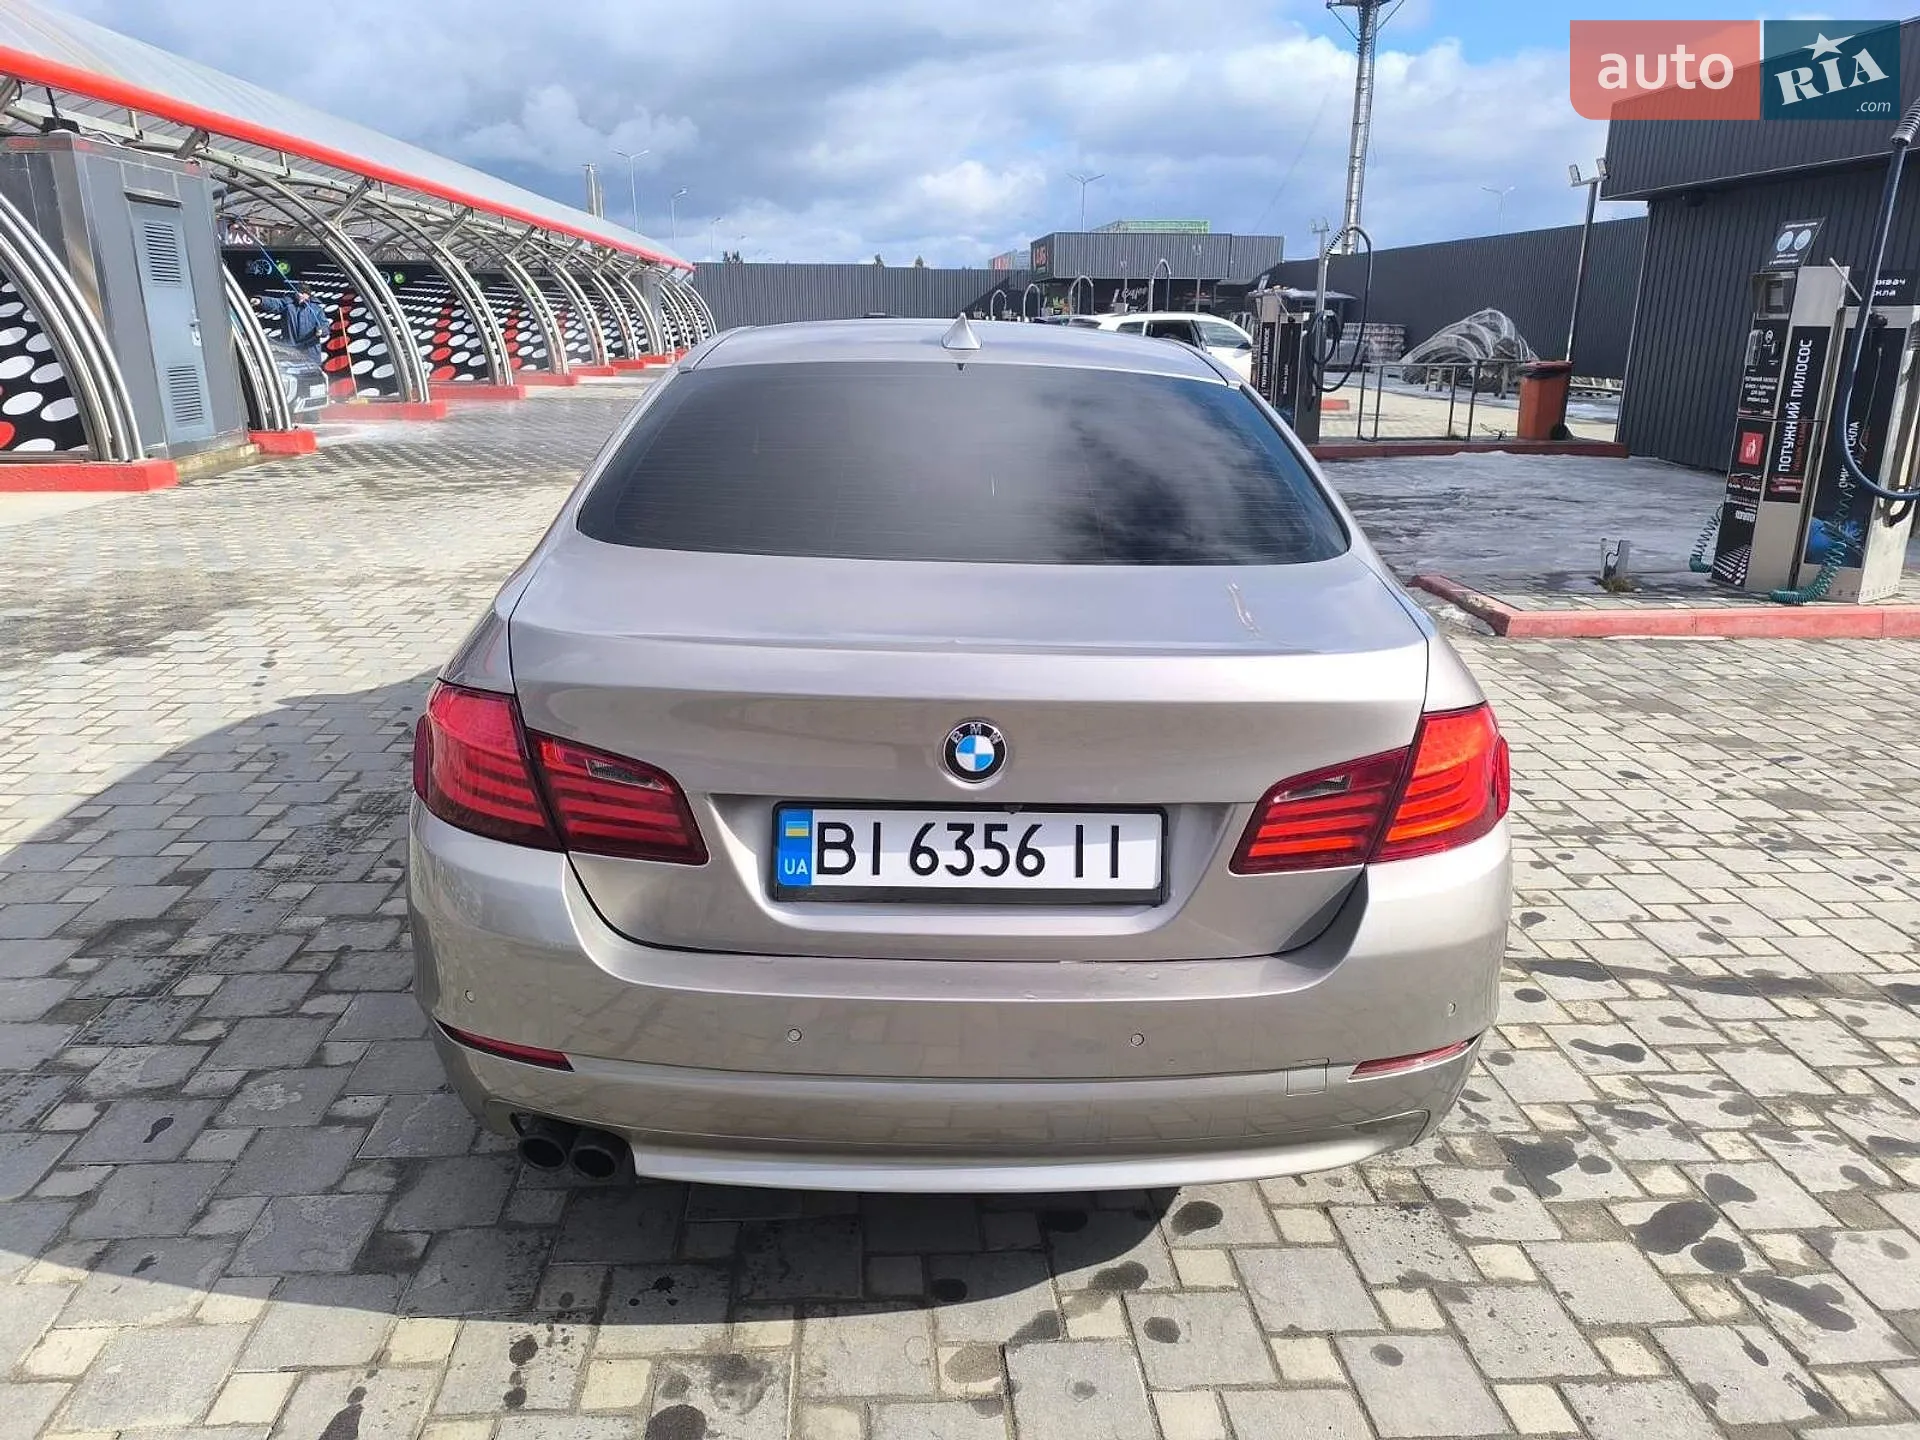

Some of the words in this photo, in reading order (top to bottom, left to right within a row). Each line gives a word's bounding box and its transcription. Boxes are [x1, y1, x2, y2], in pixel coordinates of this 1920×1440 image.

[1778, 401, 1802, 472] ПОТУЖНИЙ
[1790, 339, 1813, 398] ПИЛОСОС
[950, 723, 1003, 744] BMW
[784, 858, 809, 876] UA
[816, 821, 881, 877] BI
[908, 821, 1047, 879] 6356
[1075, 824, 1121, 879] II
